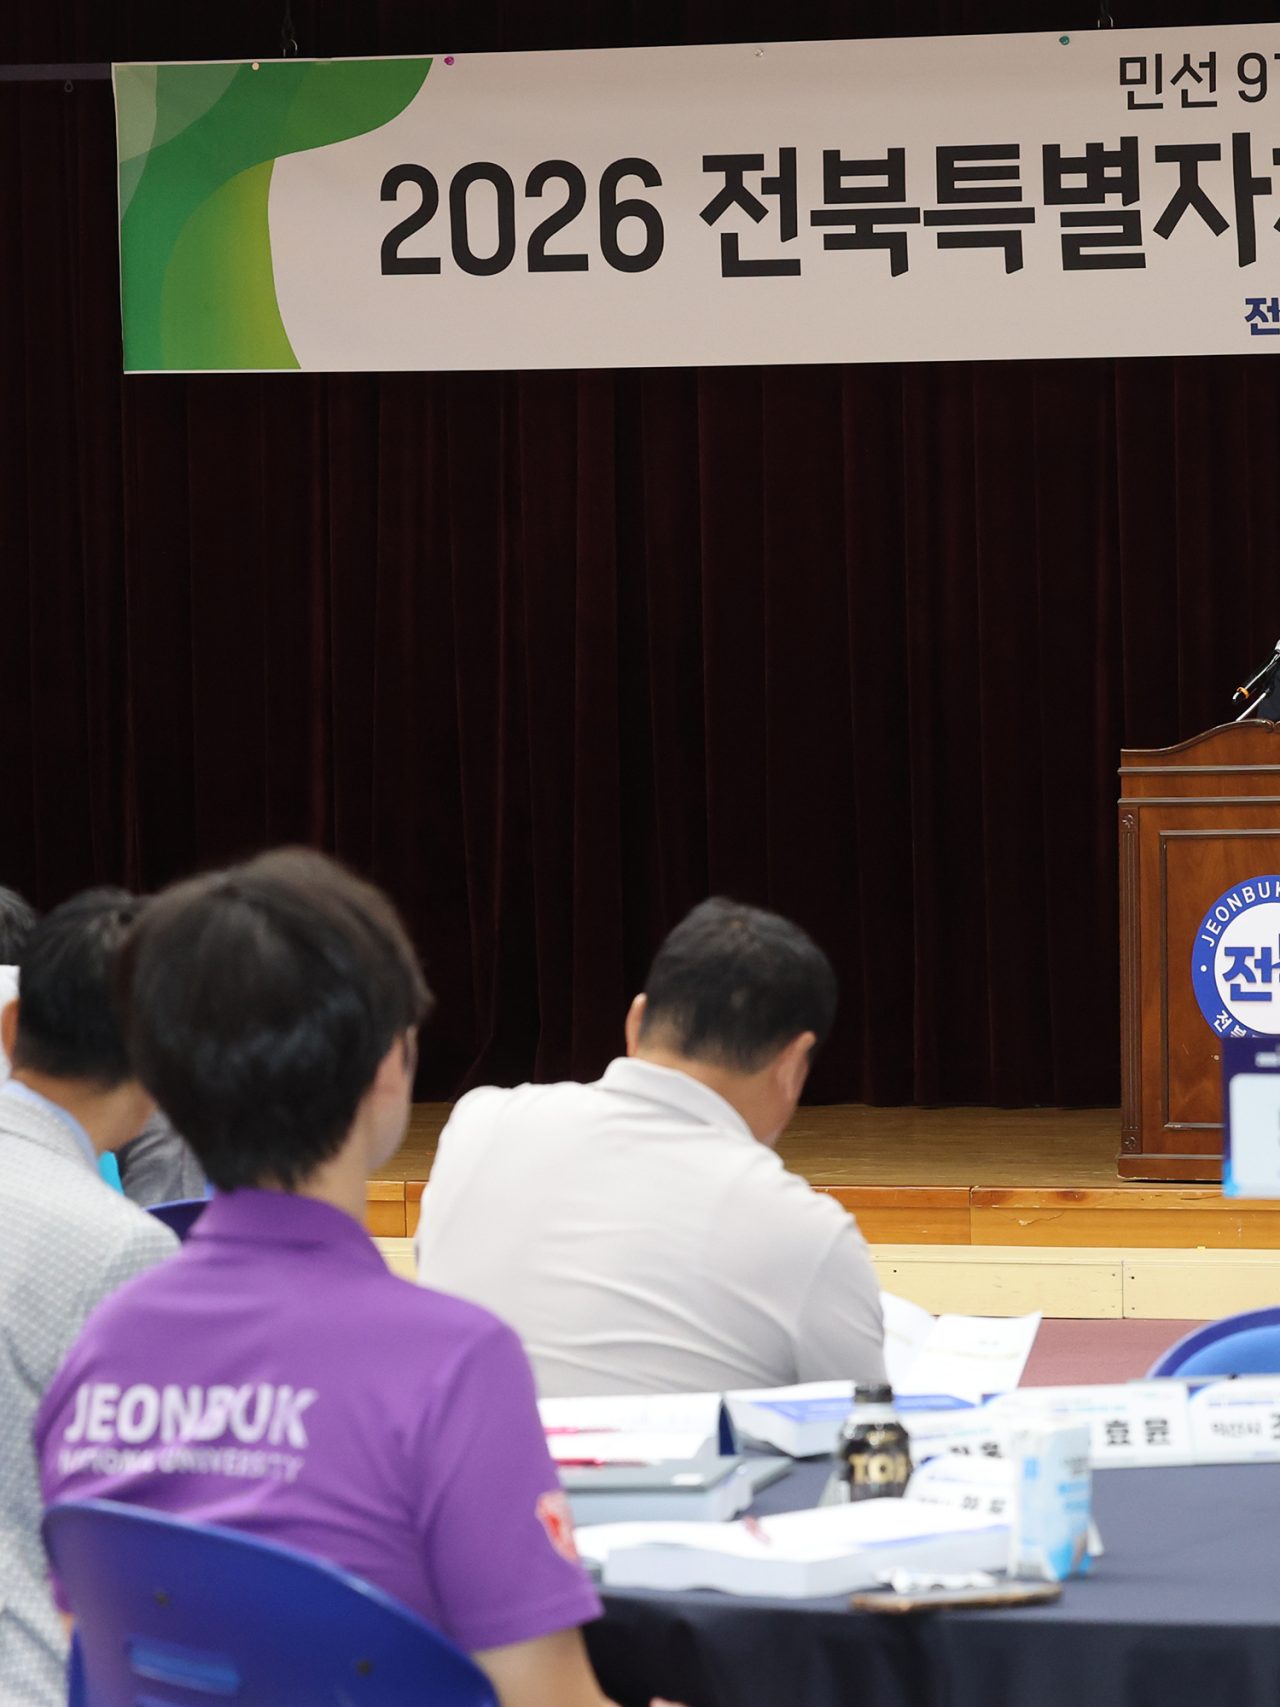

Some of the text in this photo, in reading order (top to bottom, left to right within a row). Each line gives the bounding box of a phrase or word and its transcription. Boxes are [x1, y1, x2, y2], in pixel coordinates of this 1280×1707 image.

[1118, 50, 1218, 111] 민선
[379, 157, 665, 277] 2026
[63, 1382, 320, 1450] JEONBUK
